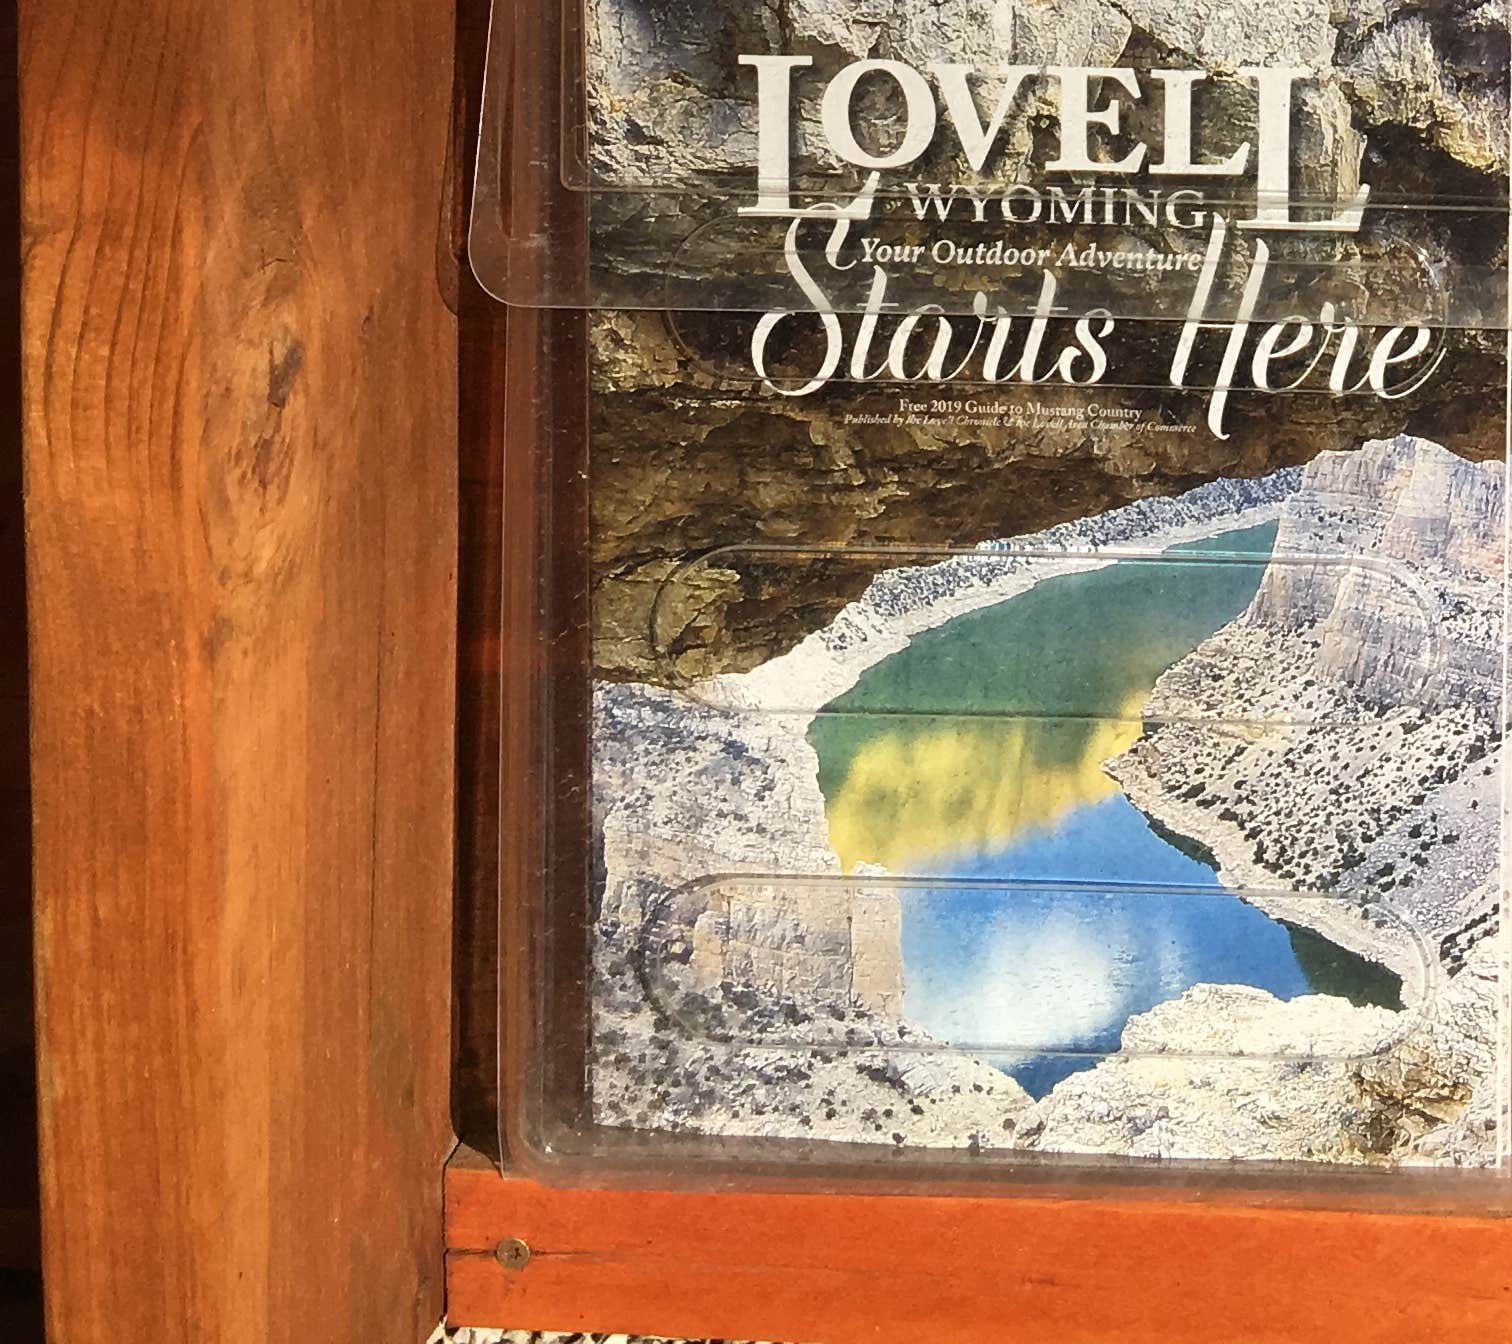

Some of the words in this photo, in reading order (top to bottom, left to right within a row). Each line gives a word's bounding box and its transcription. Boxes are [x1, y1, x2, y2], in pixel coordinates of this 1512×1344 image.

[737, 53, 1371, 233] LOVELL
[903, 182, 1208, 229] WYOMING
[860, 237, 925, 263] Your
[931, 239, 1051, 267] Outdoor
[1056, 241, 1203, 272] Adventure
[751, 202, 1116, 397] Starts
[1169, 211, 1448, 440] Here
[844, 414, 891, 425] Published
[1147, 422, 1198, 433] Commerce
[900, 398, 928, 413] Free
[931, 399, 962, 413] 2019
[965, 400, 1008, 414] Guide
[1010, 404, 1023, 414] to
[1026, 402, 1085, 421] Mustang
[1087, 403, 1143, 422] Country
